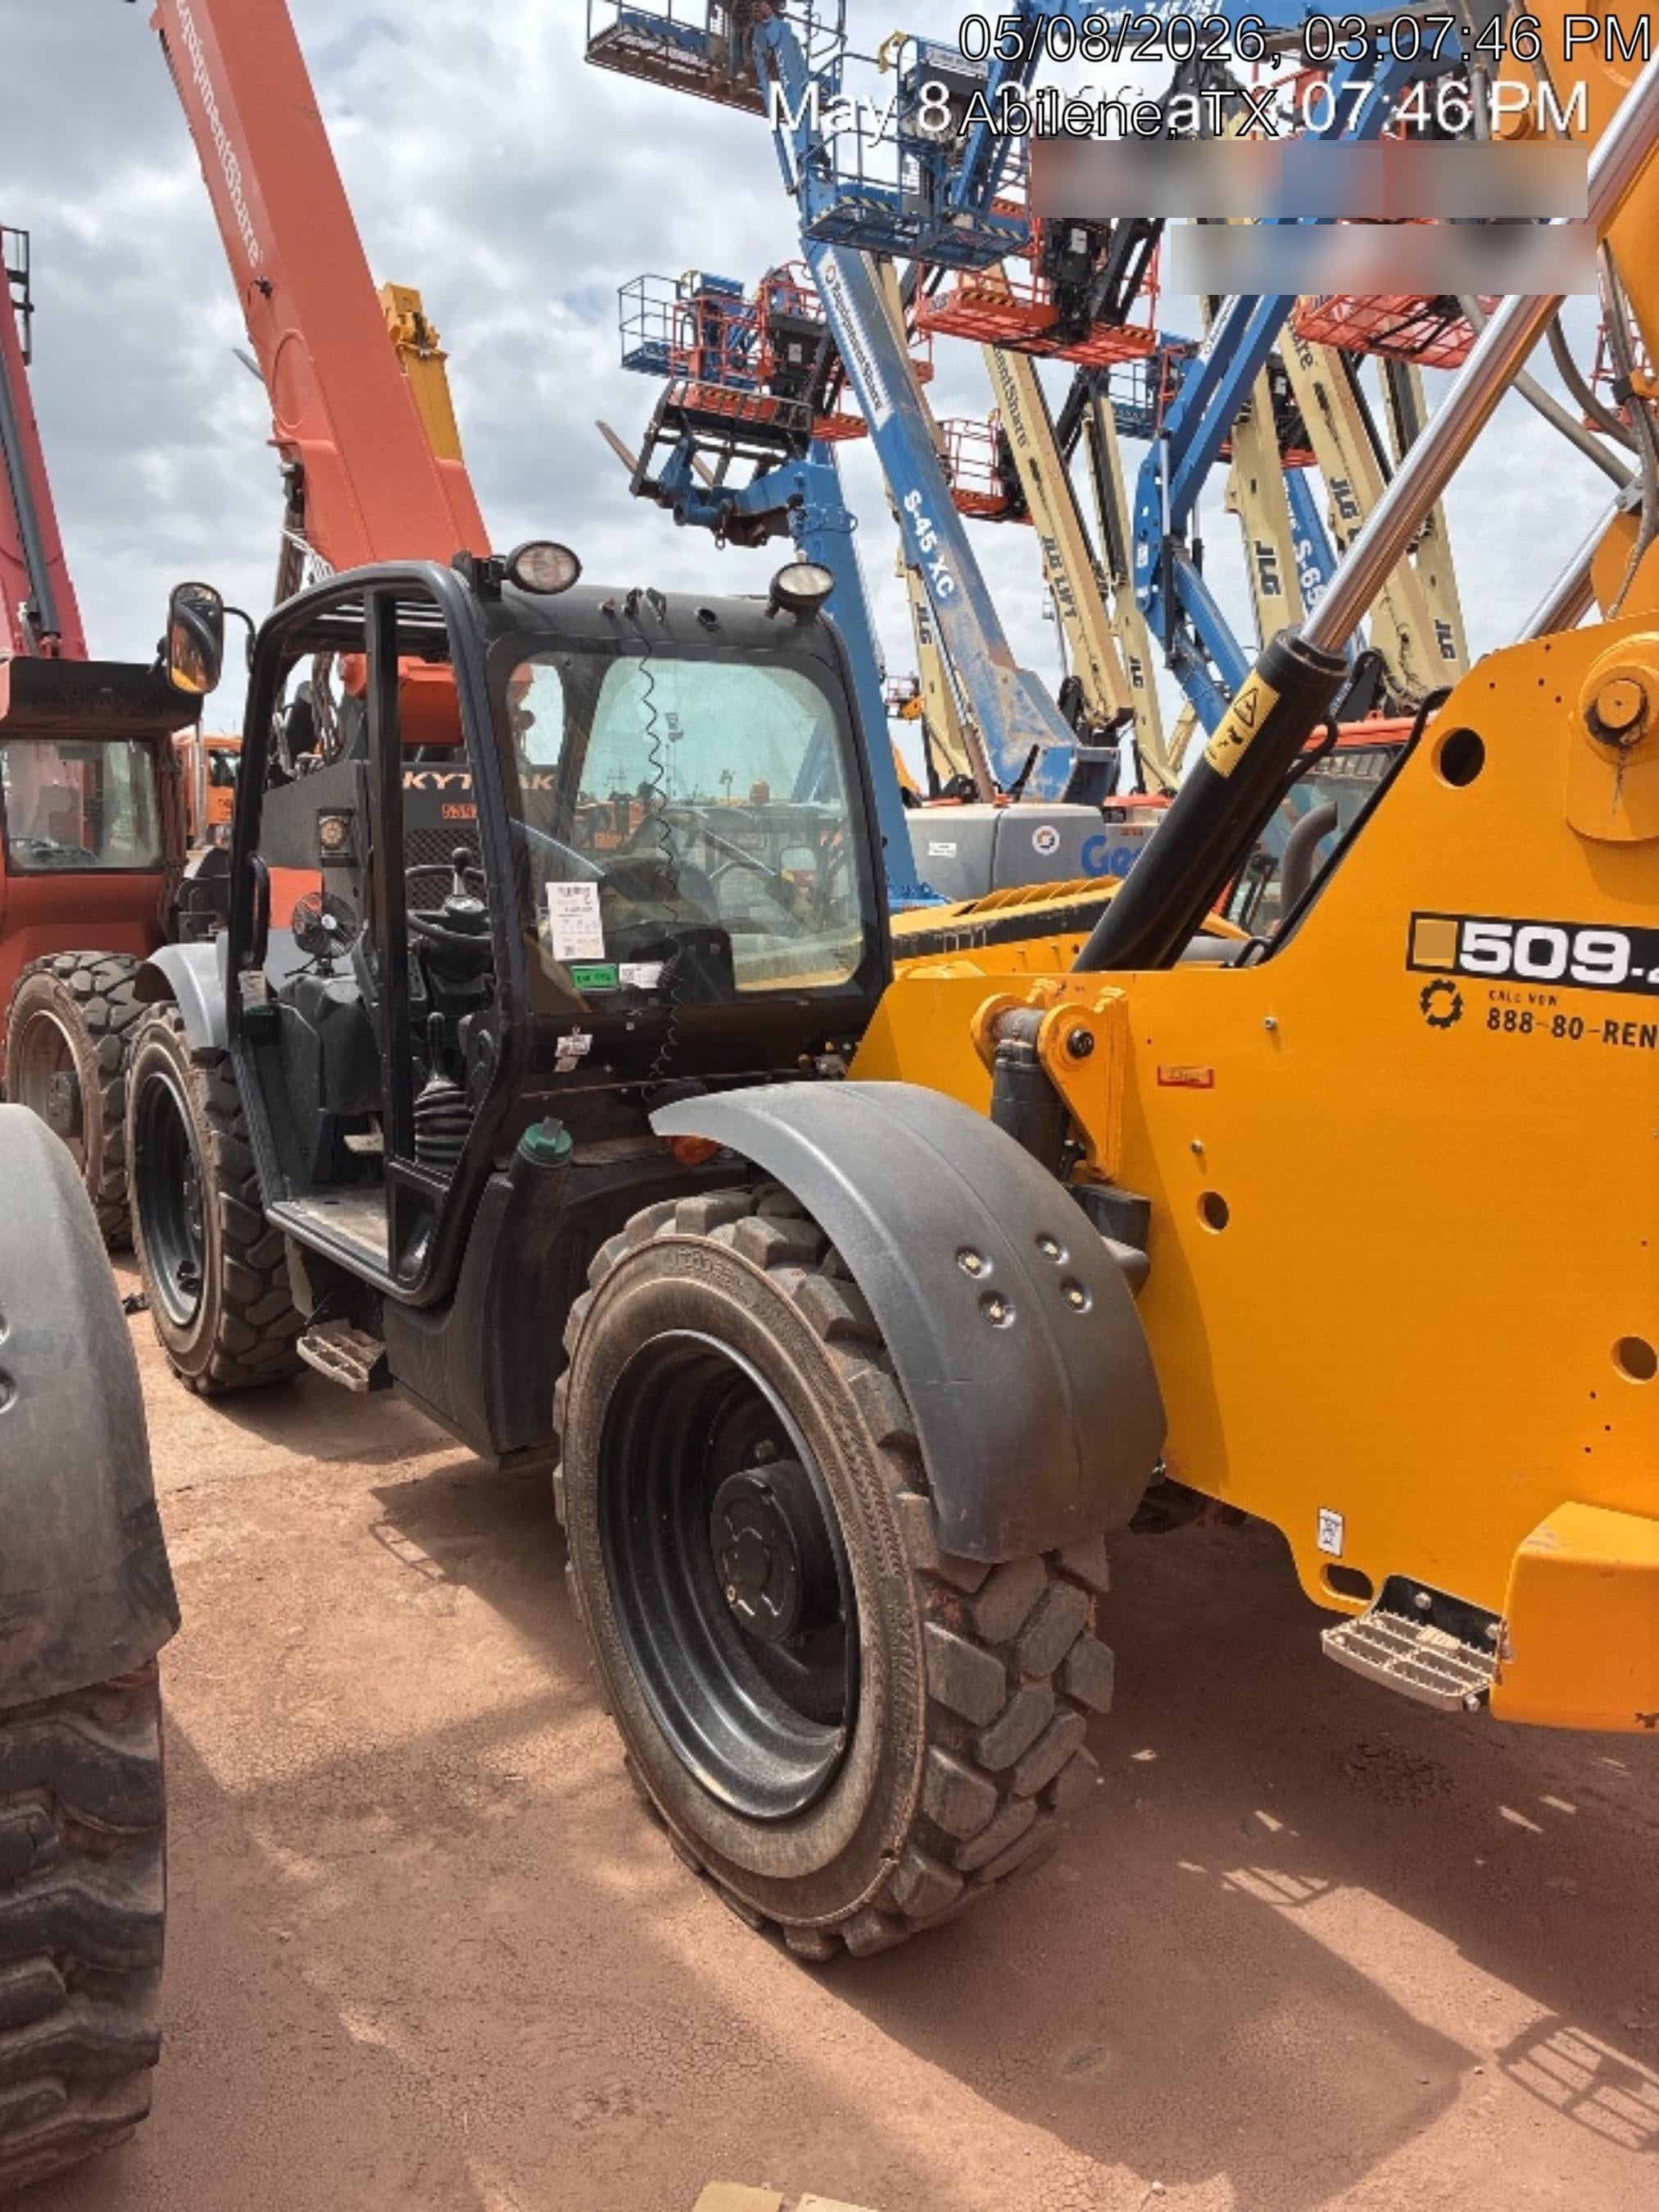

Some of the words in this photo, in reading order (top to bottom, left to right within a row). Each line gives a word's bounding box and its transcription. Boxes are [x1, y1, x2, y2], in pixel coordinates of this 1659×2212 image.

[1330, 477, 1360, 519] JLG
[904, 489, 938, 553] S-45
[927, 556, 955, 598] XC
[1253, 541, 1281, 596] JLG
[1435, 619, 1456, 659] JLG
